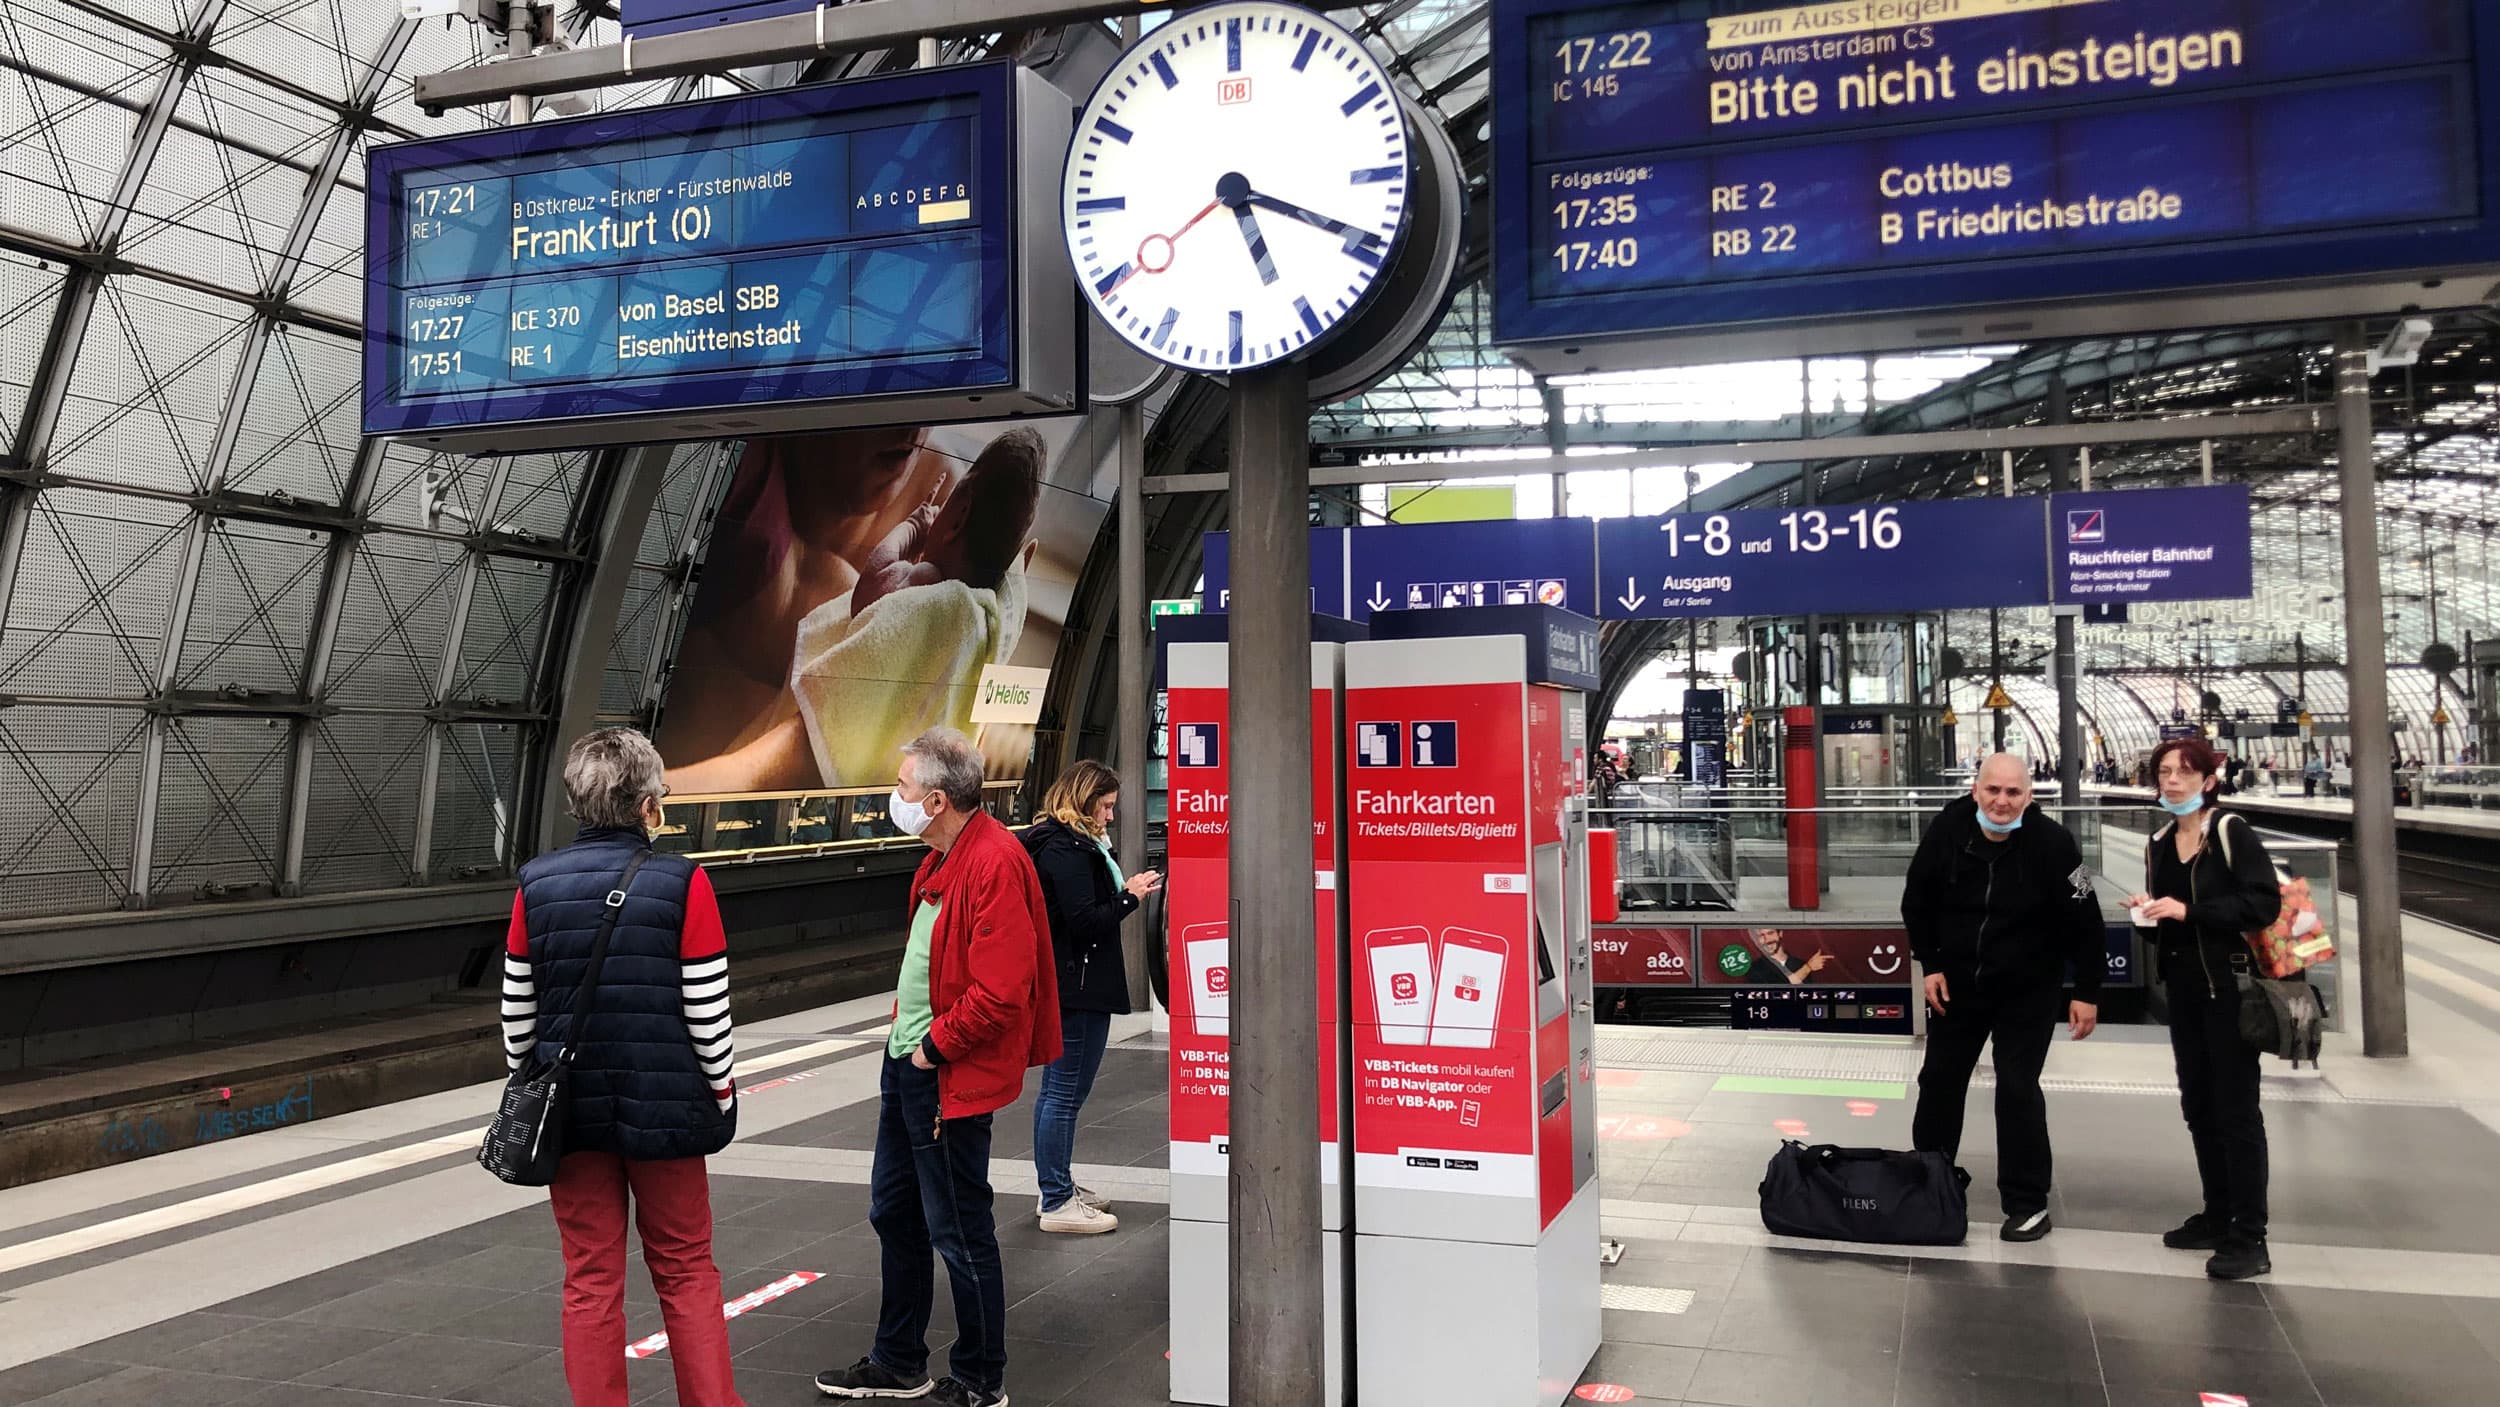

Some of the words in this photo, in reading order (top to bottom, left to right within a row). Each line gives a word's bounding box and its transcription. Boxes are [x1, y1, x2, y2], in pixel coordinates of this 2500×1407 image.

[1727, 18, 1782, 39] zum
[1791, 0, 1960, 31] Aussteigen
[1554, 31, 1652, 74] 17:22
[1710, 48, 1754, 73] von
[1760, 33, 1896, 66] Amsterdam
[1903, 26, 1935, 50] CS
[1553, 79, 1572, 101] IC
[1580, 74, 1619, 97] 145
[1709, 76, 1818, 125] Bitte
[1838, 55, 1956, 111] nicht
[1976, 28, 2243, 94] einsteigen
[1221, 82, 1248, 102] DB
[1551, 166, 1654, 190] Folgezüge:
[1879, 162, 2012, 199] Cottbus
[414, 184, 476, 217] 17:21
[513, 203, 522, 218] B
[526, 195, 595, 217] Ostkreuz
[610, 188, 662, 208] Erkner
[678, 169, 793, 199] Fürstenwalde
[857, 196, 867, 210] A
[874, 193, 882, 207] B
[890, 191, 898, 205] C
[907, 188, 916, 203] D
[923, 187, 932, 201] E
[940, 185, 948, 199] F
[957, 183, 965, 198] G
[1712, 186, 1748, 213] RE
[1758, 182, 1777, 208] 2
[1552, 194, 1638, 230] 17:35
[1881, 212, 1903, 244] B
[1917, 187, 2182, 241] Friedrichstraße
[412, 224, 429, 241] RE
[434, 222, 442, 237] 1
[512, 212, 658, 261] Frankfurt
[1713, 230, 1751, 257] RB
[1761, 225, 1797, 253] 22
[1552, 237, 1638, 273] 17:40
[409, 293, 475, 311] Folgezüge:
[619, 302, 656, 323] von
[665, 289, 725, 318] Basel
[736, 284, 780, 311] SBB
[410, 316, 464, 342] 17:27
[512, 311, 539, 332] ICE
[546, 306, 580, 327] 370
[619, 323, 801, 360] Eisenhüttenstadt
[409, 351, 463, 377] 17:51
[512, 347, 535, 367] RE
[543, 345, 553, 365] 1
[1660, 515, 1732, 557] 1-8
[1741, 538, 1772, 554] und
[1780, 507, 1902, 552] 13-16
[2069, 549, 2149, 566] Rauchfreier
[2153, 546, 2214, 562] Bahnhof
[1662, 575, 1732, 592] Ausgang
[2070, 570, 2134, 582] Non-Smoking
[2137, 568, 2171, 579] Station
[2070, 584, 2092, 593] Gare
[2095, 582, 2150, 593] non-fumeur
[994, 683, 1030, 705] Helios
[1176, 789, 1229, 813] Fahr
[1356, 789, 1495, 815] Fahrkarten
[1357, 822, 1517, 840] Tickets/Billets/Biglietti
[1496, 879, 1510, 888] DB
[1593, 938, 1628, 955] stay
[1647, 952, 1684, 968] a&o
[1747, 1007, 1769, 1019] 1-8
[1814, 1008, 1822, 1017] U
[1866, 1008, 1874, 1017] S
[1180, 1067, 1192, 1077] Im
[1195, 1067, 1212, 1078] DB
[1364, 1059, 1439, 1074] VBB-Tickets
[1441, 1064, 1471, 1076] mobil
[1474, 1065, 1514, 1078] kaufen!
[1180, 1083, 1188, 1094] in
[1191, 1084, 1207, 1095] der
[1365, 1077, 1378, 1087] Im
[1381, 1077, 1399, 1088] DB
[1401, 1078, 1464, 1093] Navigator
[1466, 1083, 1492, 1094] oder
[1365, 1094, 1374, 1104] in
[1376, 1095, 1394, 1105] der
[1396, 1095, 1457, 1111] VBB-App.
